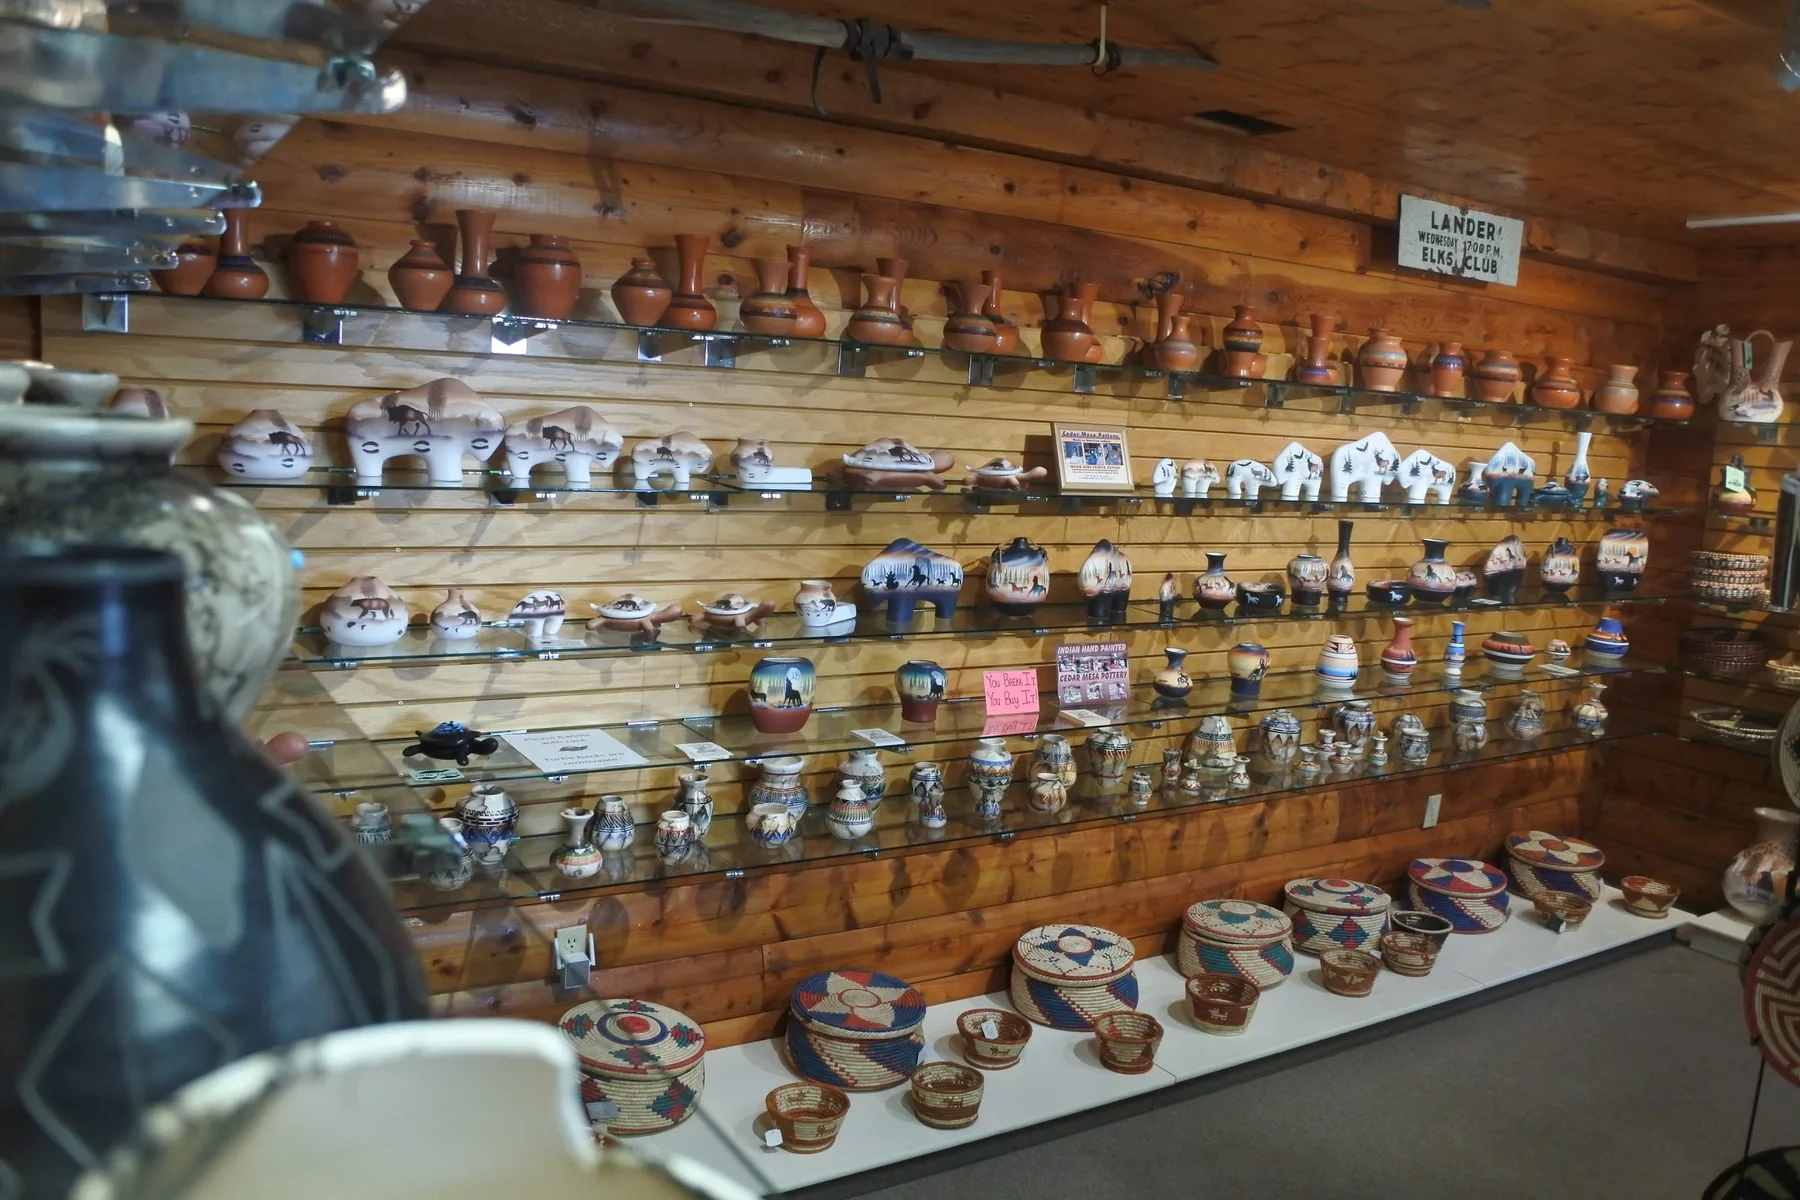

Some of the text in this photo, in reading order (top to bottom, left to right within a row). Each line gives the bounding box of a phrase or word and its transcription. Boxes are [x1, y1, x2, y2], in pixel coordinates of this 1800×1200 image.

[1418, 230, 1459, 249] WEDNESDAY
[1422, 246, 1498, 274] ELKS CLUB
[1057, 643, 1126, 654] INDIAN HAND PAINTED
[1060, 670, 1128, 682] CEDAR MESA POTTERY
[563, 757, 619, 765] removable
